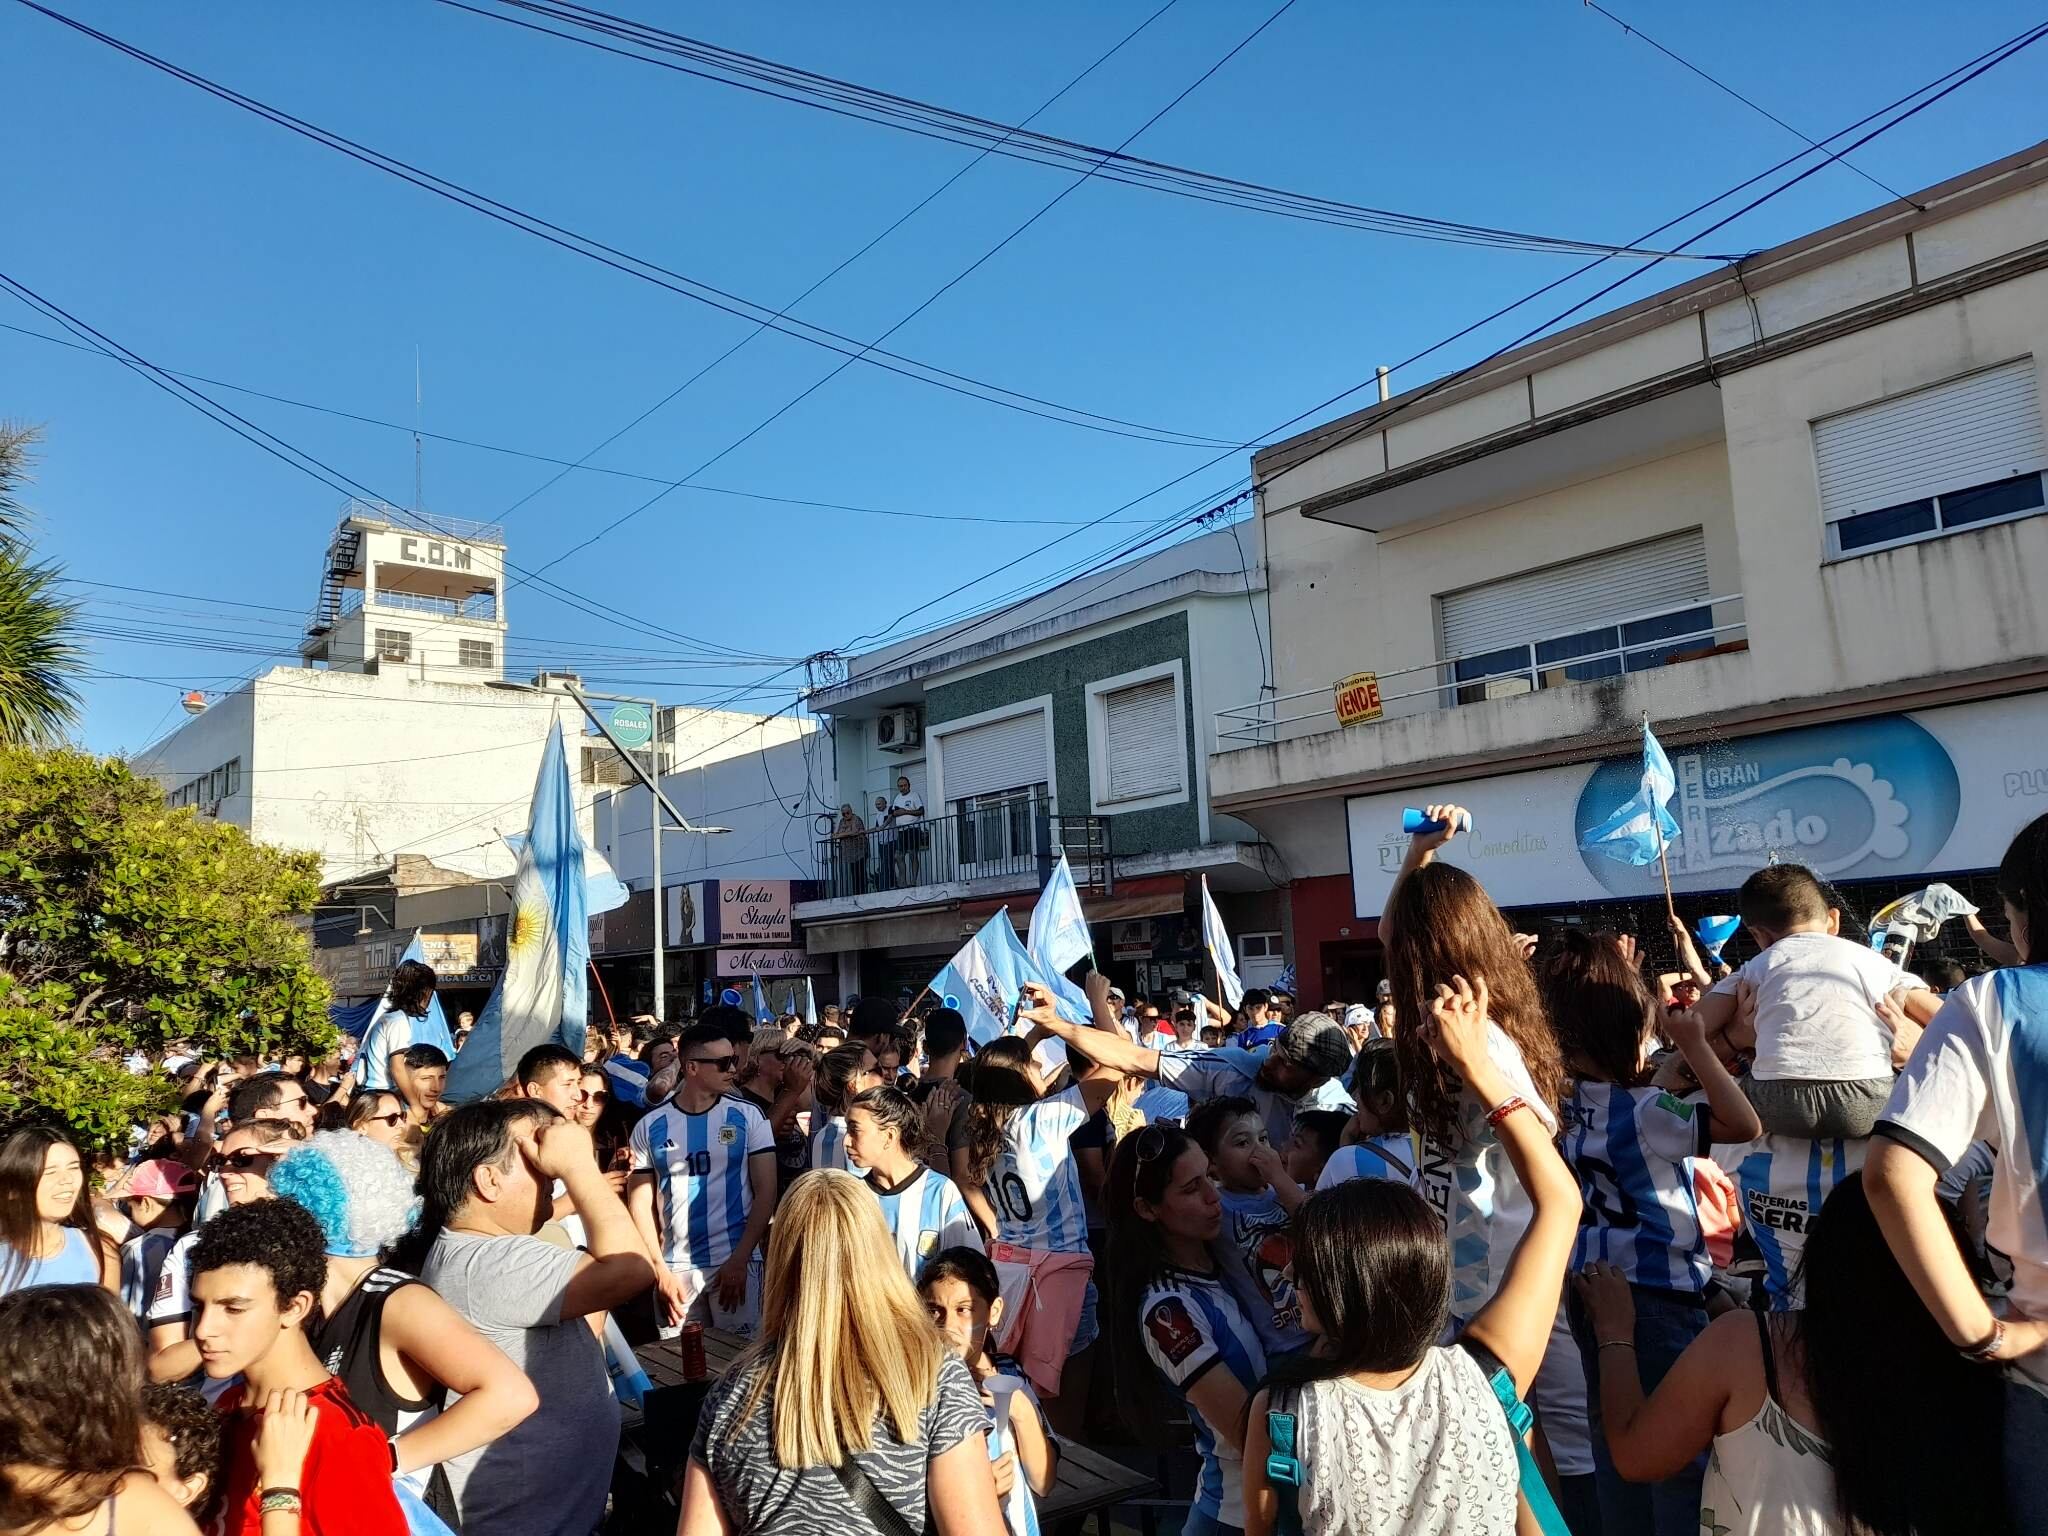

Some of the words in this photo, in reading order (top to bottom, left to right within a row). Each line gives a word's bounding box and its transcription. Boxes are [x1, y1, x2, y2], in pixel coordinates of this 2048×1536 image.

[1335, 683, 1380, 718] VENDE
[614, 718, 648, 729] ROSALES
[1705, 761, 1760, 789] GRAN
[1709, 808, 1829, 854] zado
[1467, 829, 1550, 860] Comoditas
[723, 884, 773, 903] Modas
[740, 905, 786, 930] Shayla
[423, 941, 457, 949] CNICA
[722, 932, 734, 940] ROPA
[736, 932, 748, 940] PARA
[750, 932, 762, 940] TODA
[771, 931, 790, 939] FAMILIA
[729, 950, 775, 969] Modas
[777, 950, 817, 972] Shayla
[437, 974, 460, 982] RGA
[685, 1150, 711, 1177] 10
[989, 1171, 1033, 1223] 10
[1748, 1189, 1808, 1211] BATERIAS
[1749, 1202, 1809, 1235] SER
